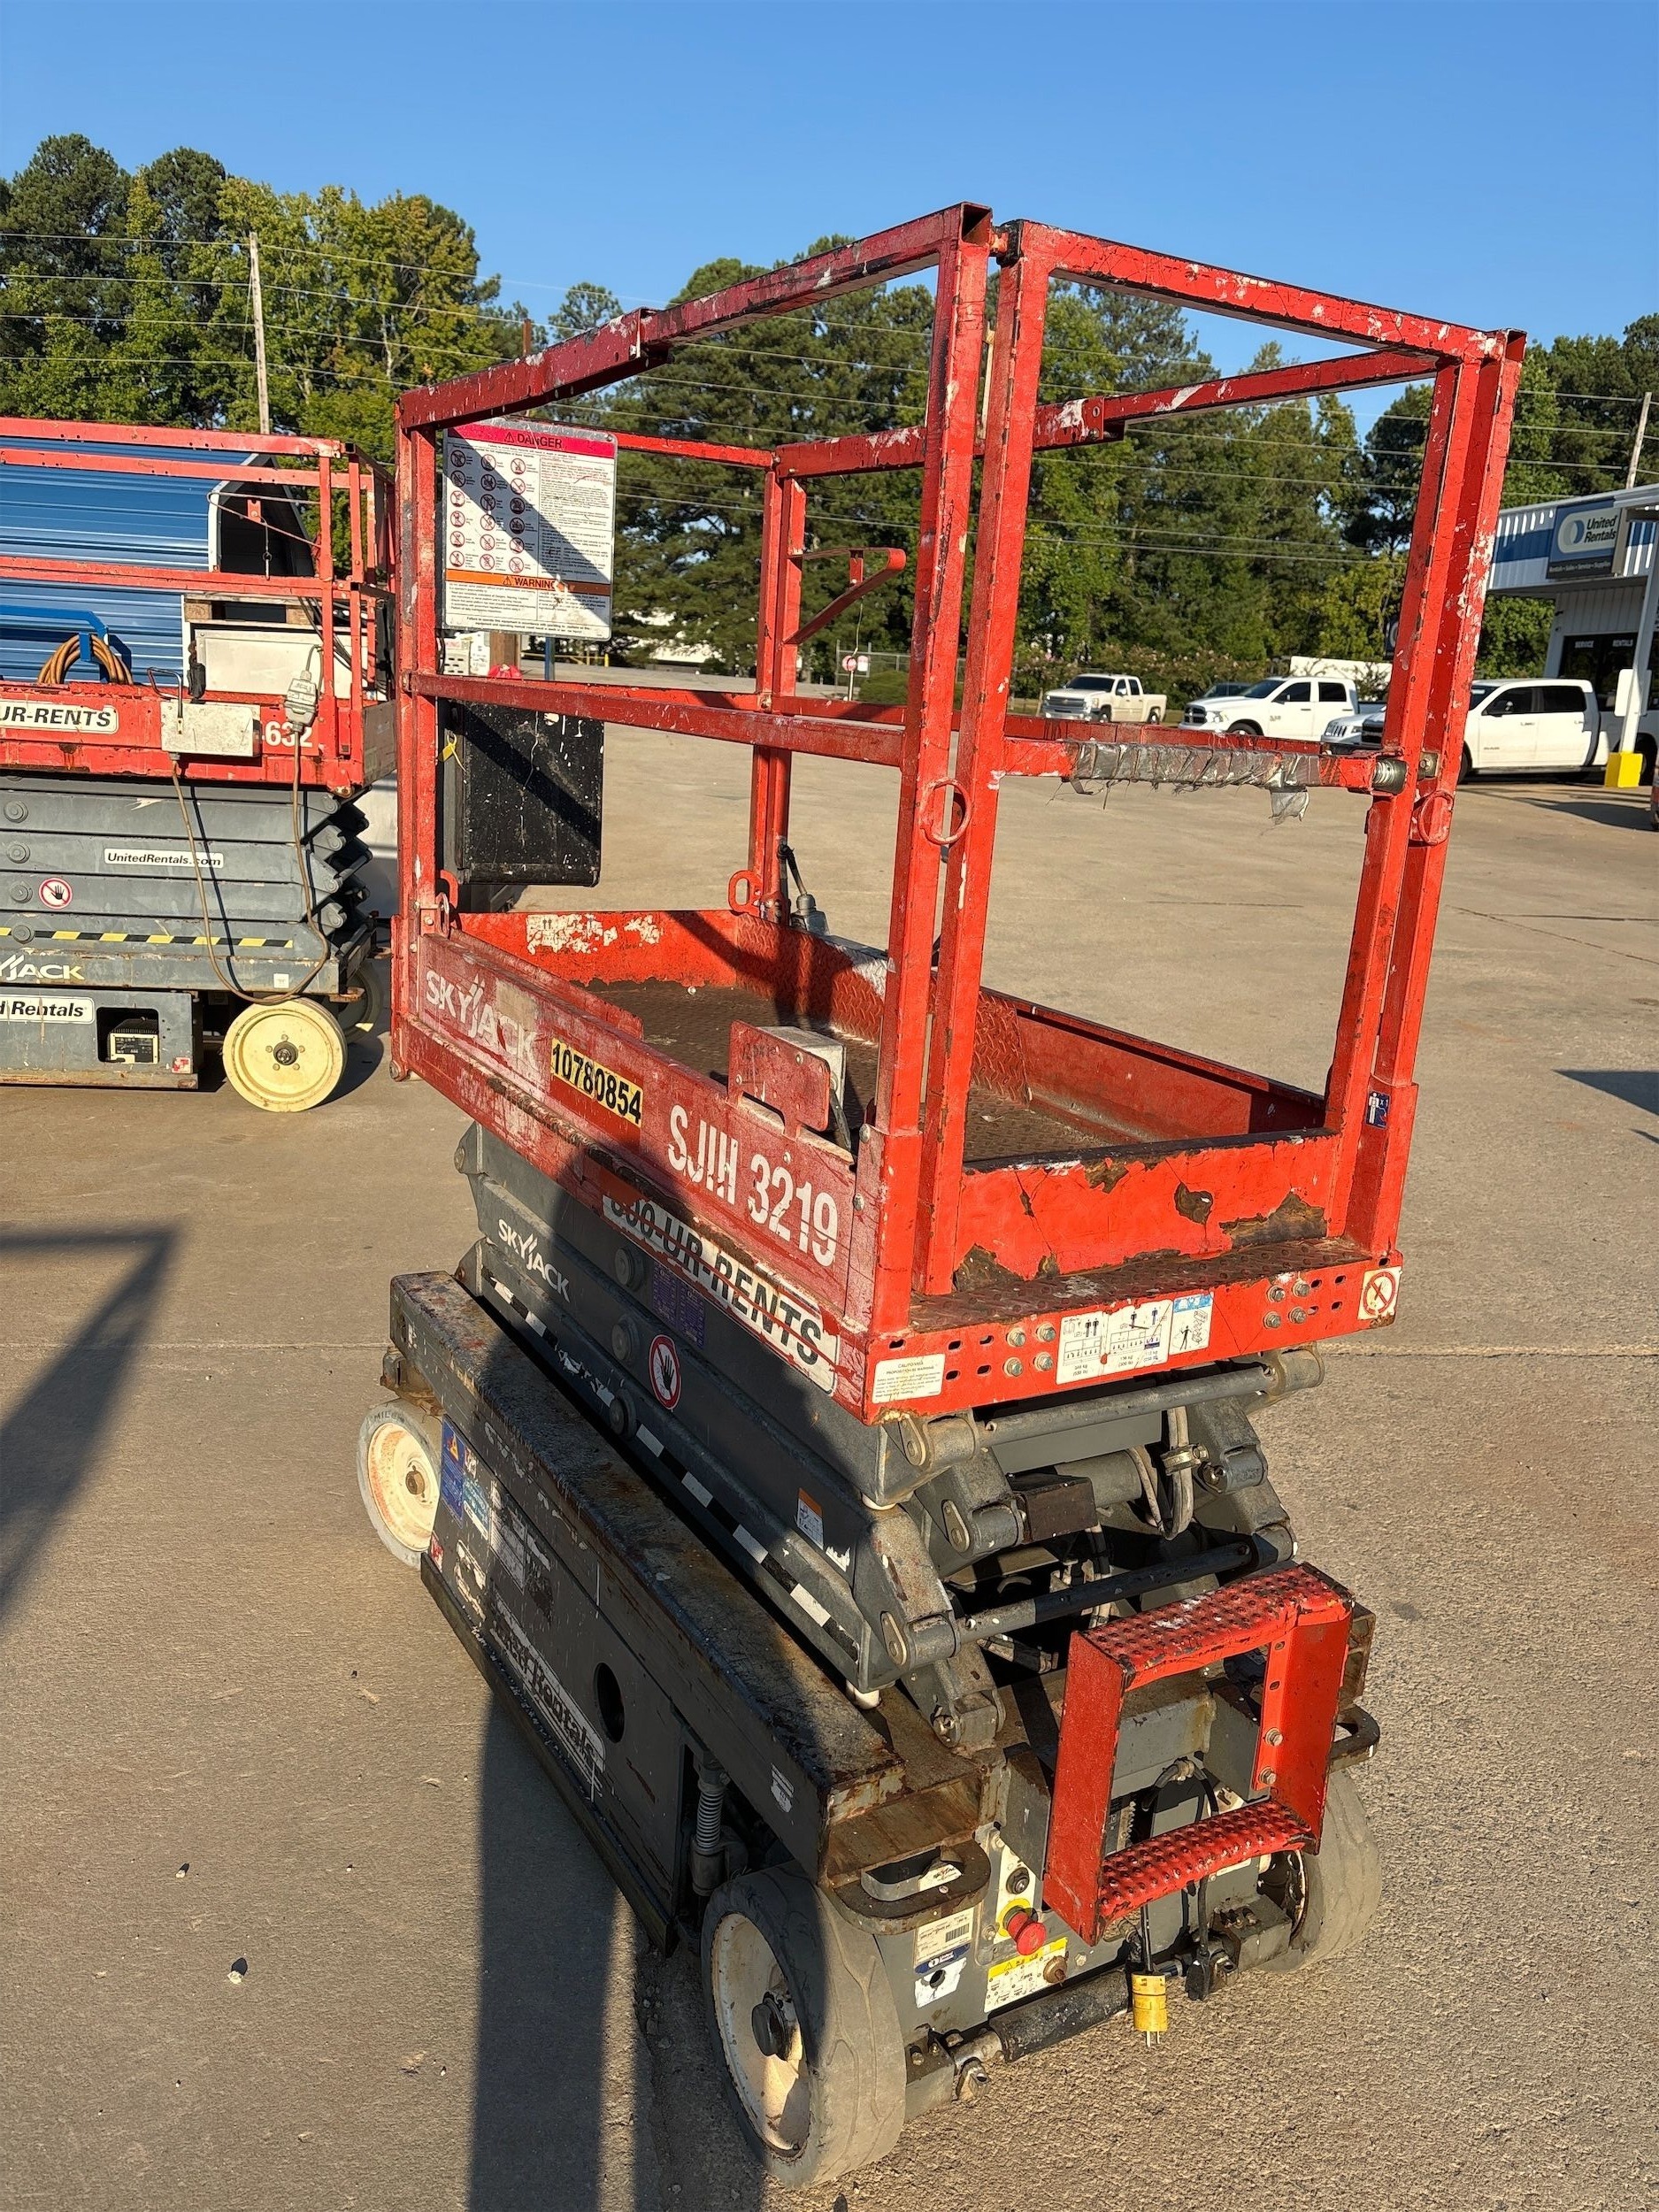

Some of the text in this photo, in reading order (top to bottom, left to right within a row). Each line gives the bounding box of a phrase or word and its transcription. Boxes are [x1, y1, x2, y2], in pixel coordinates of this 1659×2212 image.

[517, 434, 563, 449] DANGER
[1586, 515, 1618, 530] United
[1584, 530, 1617, 543] Rentals
[107, 852, 221, 866] UnitedRentals.com
[11, 1001, 84, 1018] Rentals
[425, 969, 540, 1072] SKYJACK
[552, 1042, 641, 1125] 10780854
[747, 1153, 839, 1268] 3219
[497, 1217, 571, 1304] SKYJACK
